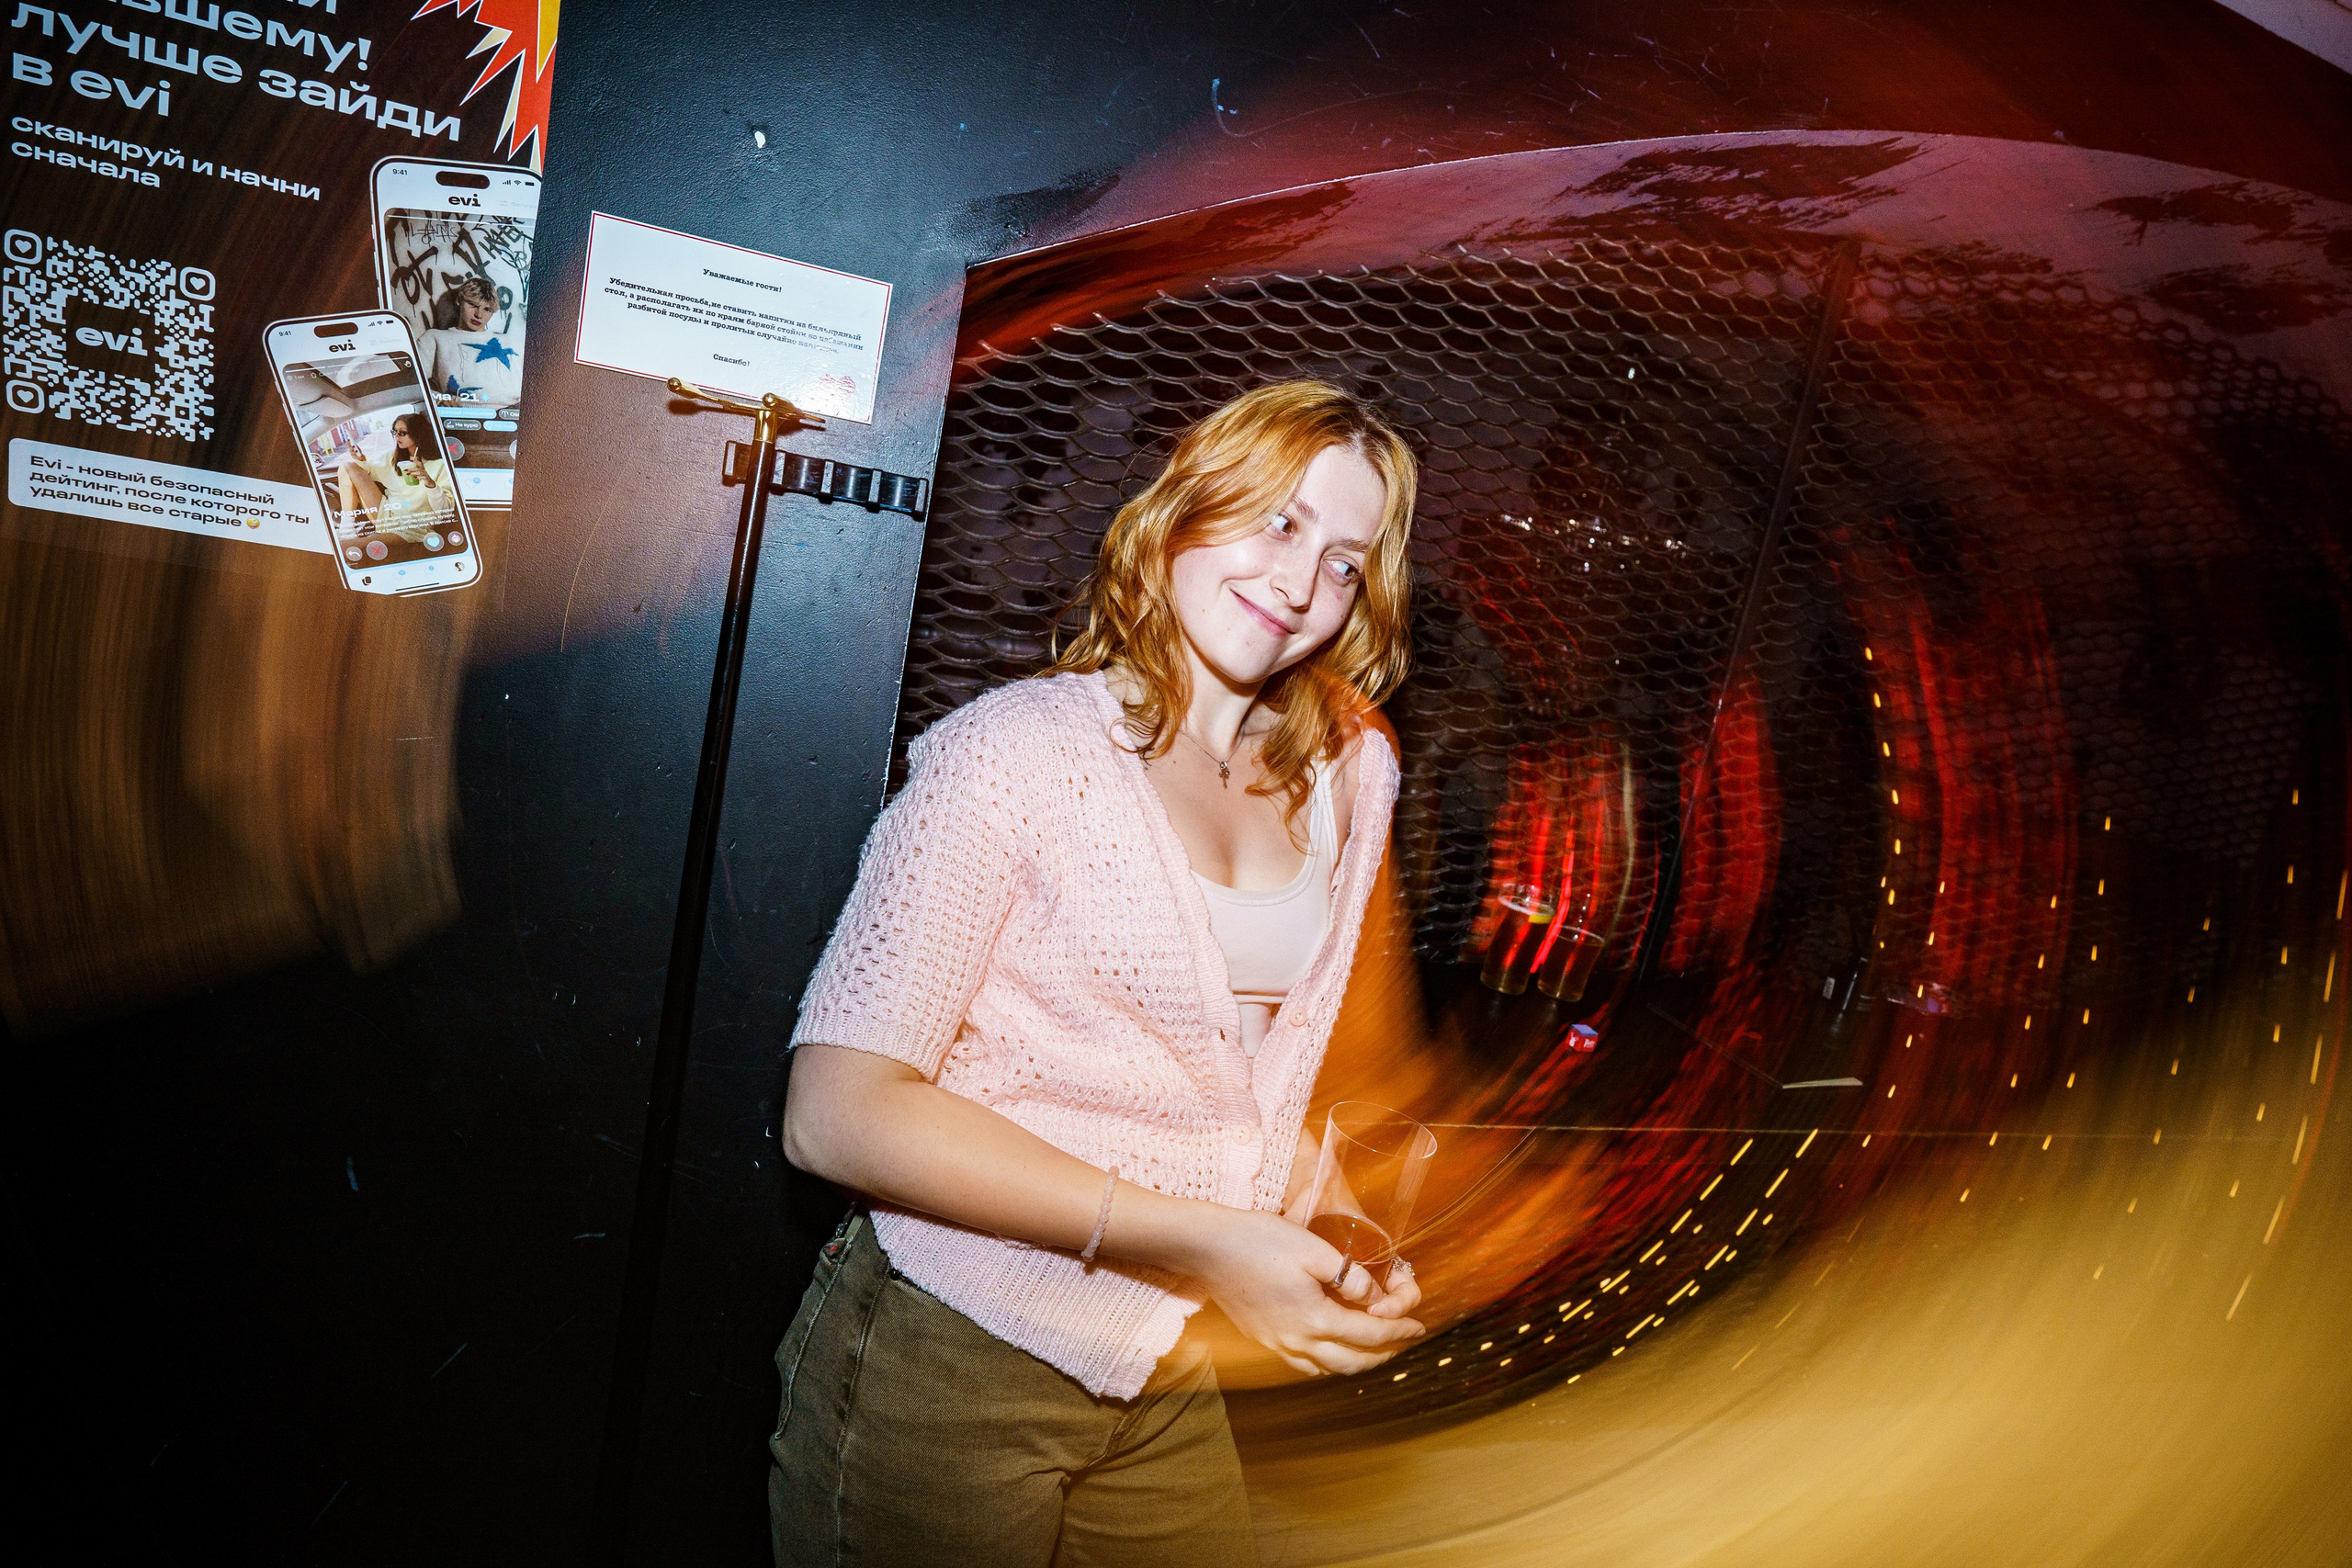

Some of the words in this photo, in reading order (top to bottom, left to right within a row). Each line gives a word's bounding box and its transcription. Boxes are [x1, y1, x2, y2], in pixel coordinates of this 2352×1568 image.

[11, 2, 243, 84] лучше
[258, 69, 460, 141] зайди
[13, 52, 53, 86] в
[70, 70, 171, 117] evi
[11, 117, 185, 169] сканируй
[192, 158, 213, 176] и
[220, 165, 320, 200] начни
[11, 141, 160, 187] сначала
[448, 194, 481, 207] evi
[703, 268, 753, 286] Уважаемые
[755, 282, 782, 293] гости!
[605, 287, 628, 299] стол,
[636, 293, 691, 311] располагать
[718, 312, 745, 323] краям
[746, 318, 775, 331] барной
[777, 326, 807, 337] стойки
[609, 277, 673, 298] Убедительная
[723, 304, 756, 317] ставить
[759, 312, 795, 326] напитки
[808, 323, 861, 341] бильярдный
[628, 301, 667, 316] разбитой
[669, 311, 702, 323] посуды
[711, 321, 755, 336] пролитых
[756, 331, 797, 345] случайно
[75, 327, 148, 356] evi
[329, 339, 356, 353] evi
[713, 354, 751, 367] Спасибо!
[460, 393, 479, 401] 21
[29, 472, 120, 494] дейтинг,
[125, 488, 187, 503] после
[191, 498, 281, 519] которого
[285, 513, 309, 524] ты
[30, 456, 62, 469] Evi
[78, 466, 145, 483] новый
[151, 476, 274, 504] безопасный
[29, 486, 123, 508] удалишь
[128, 502, 164, 514] все
[169, 509, 242, 526] старые
[334, 507, 378, 518] Мария
[384, 502, 401, 512] 20
